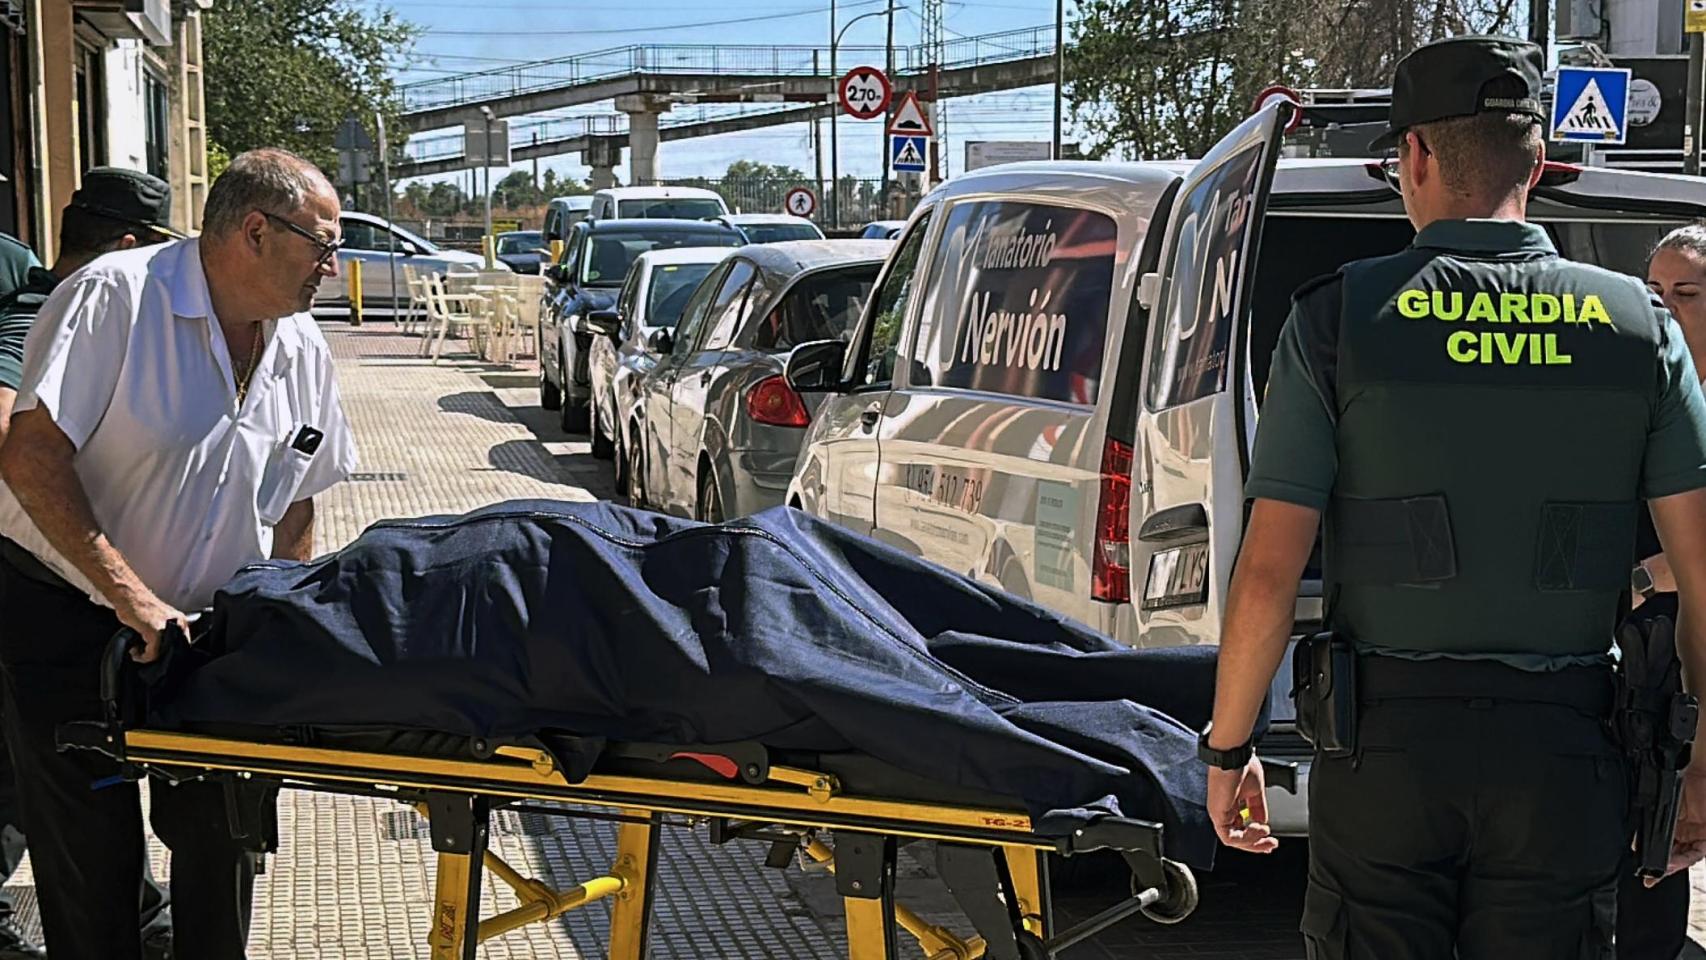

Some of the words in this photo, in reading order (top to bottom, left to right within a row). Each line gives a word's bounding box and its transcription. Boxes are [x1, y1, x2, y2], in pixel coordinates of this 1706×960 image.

[1397, 289, 1611, 324] GUARDIA
[961, 288, 1067, 372] Nervión
[1447, 331, 1572, 365] CIVIL
